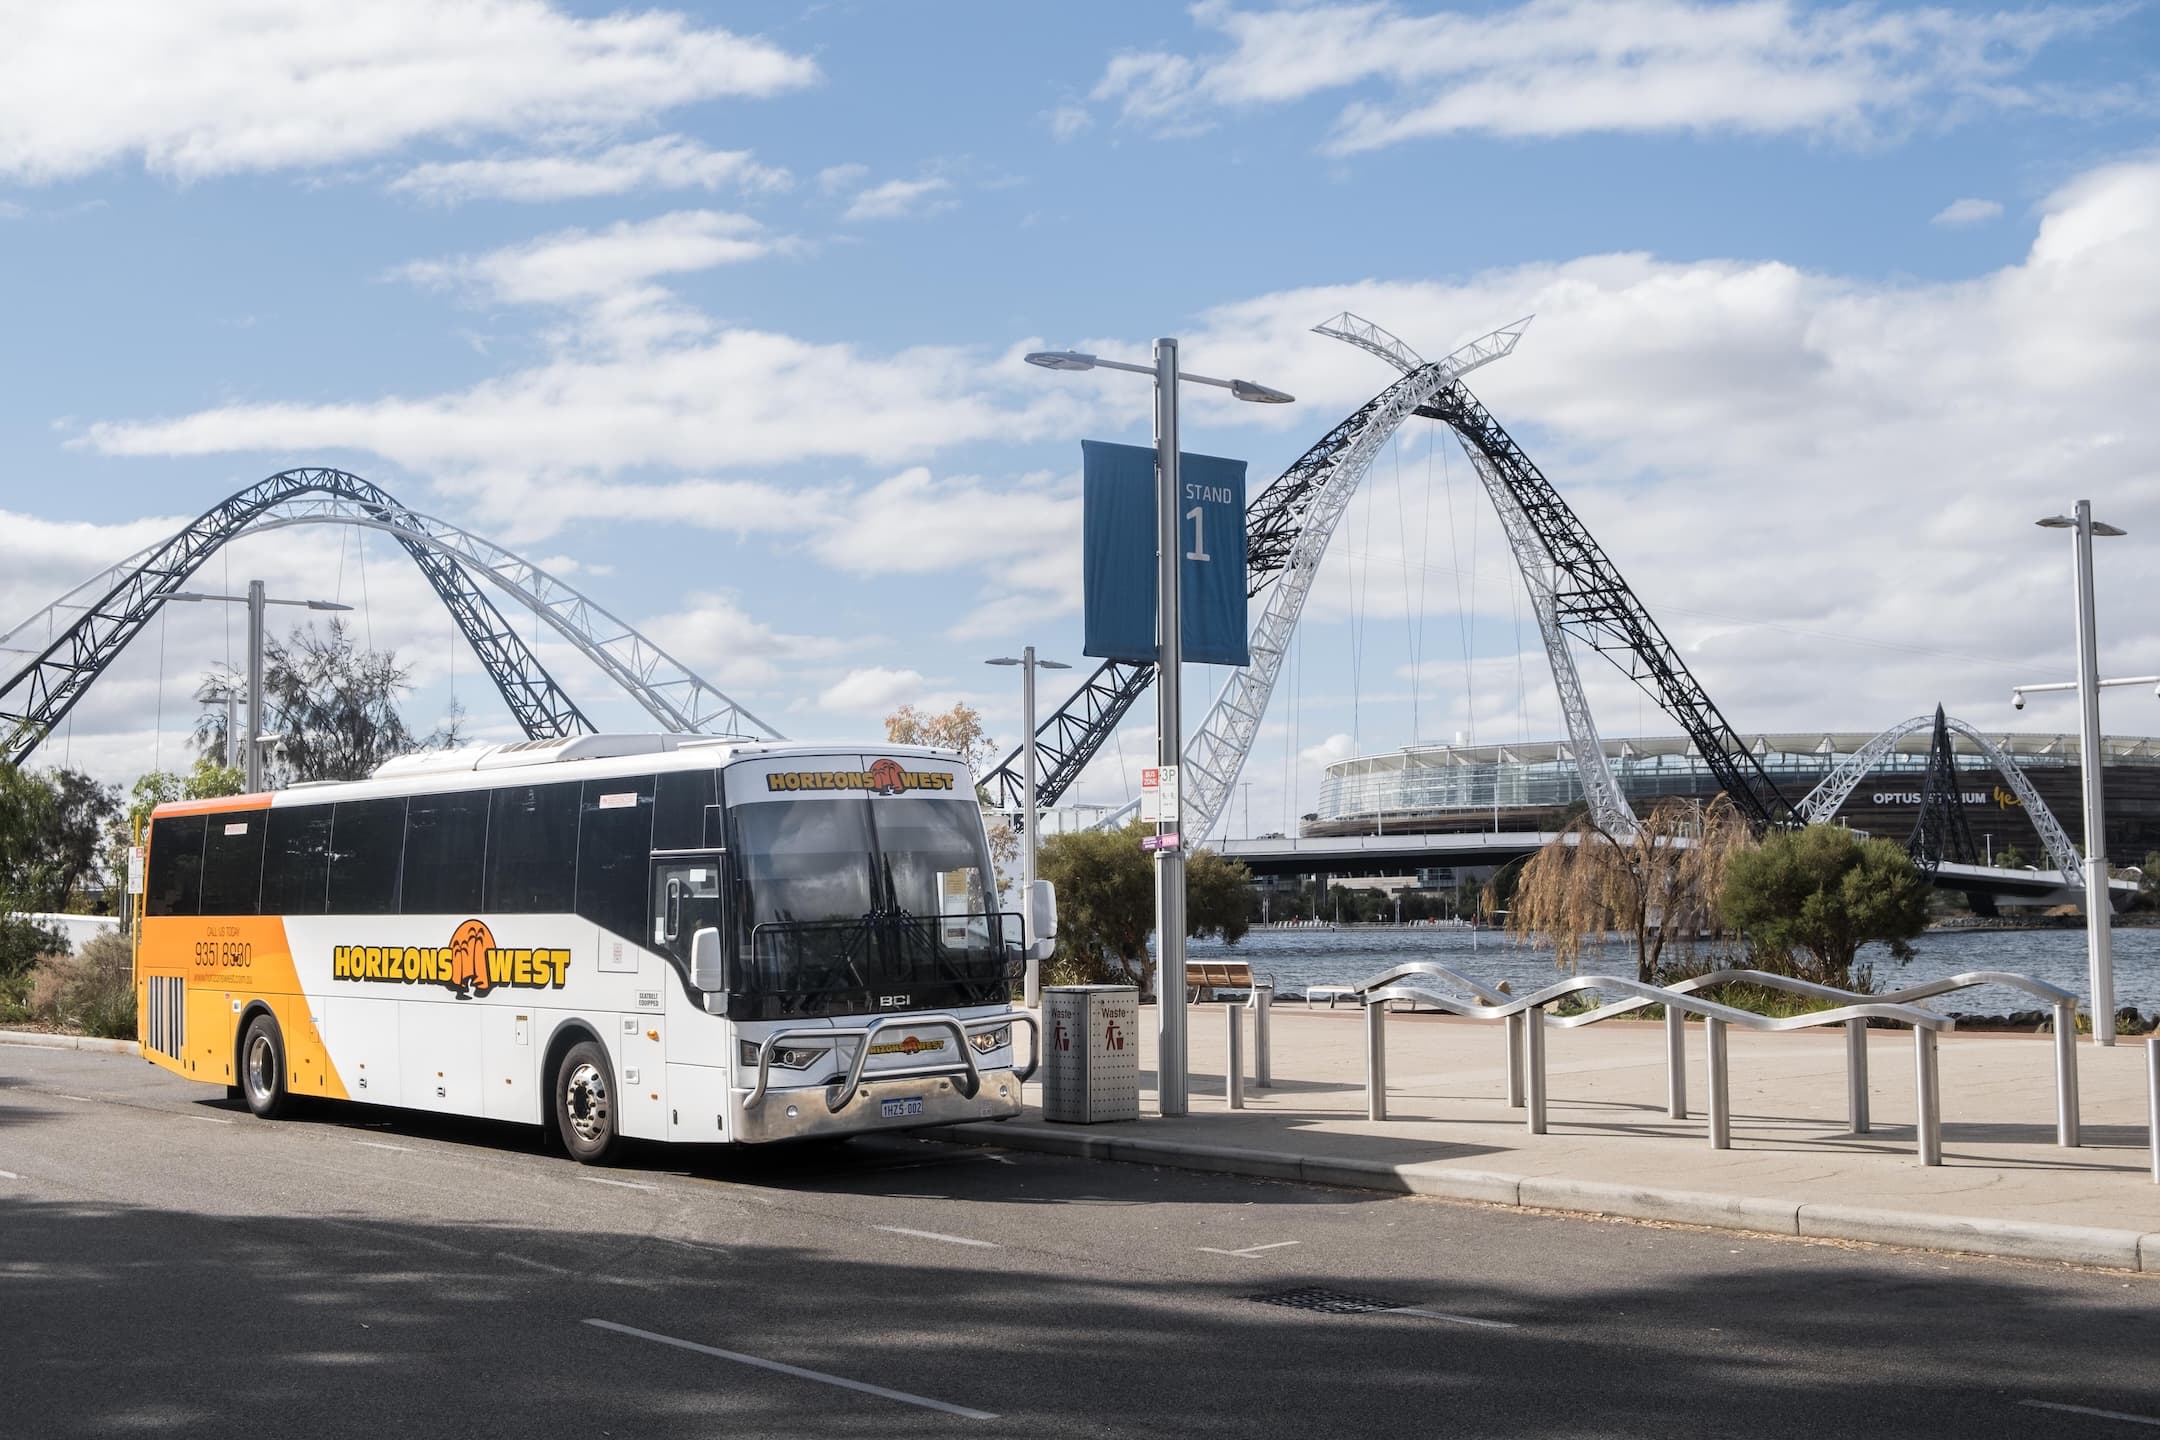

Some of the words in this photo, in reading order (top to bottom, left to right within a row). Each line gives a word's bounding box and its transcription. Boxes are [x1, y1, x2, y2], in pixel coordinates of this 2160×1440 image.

[1186, 483, 1232, 504] STAND
[1186, 506, 1210, 561] 1
[766, 772, 874, 792] HORIZONS
[900, 772, 954, 790] WEST
[1162, 768, 1176, 782] 3P
[1873, 793, 1922, 804] OPTUS
[195, 942, 219, 966] 9351
[333, 945, 452, 984] HORIZONS
[486, 948, 571, 990] WEST
[880, 995, 911, 1007] BCI
[1051, 1007, 1073, 1019] Waste
[1101, 1007, 1127, 1019] Waste
[916, 1040, 945, 1051] WEST
